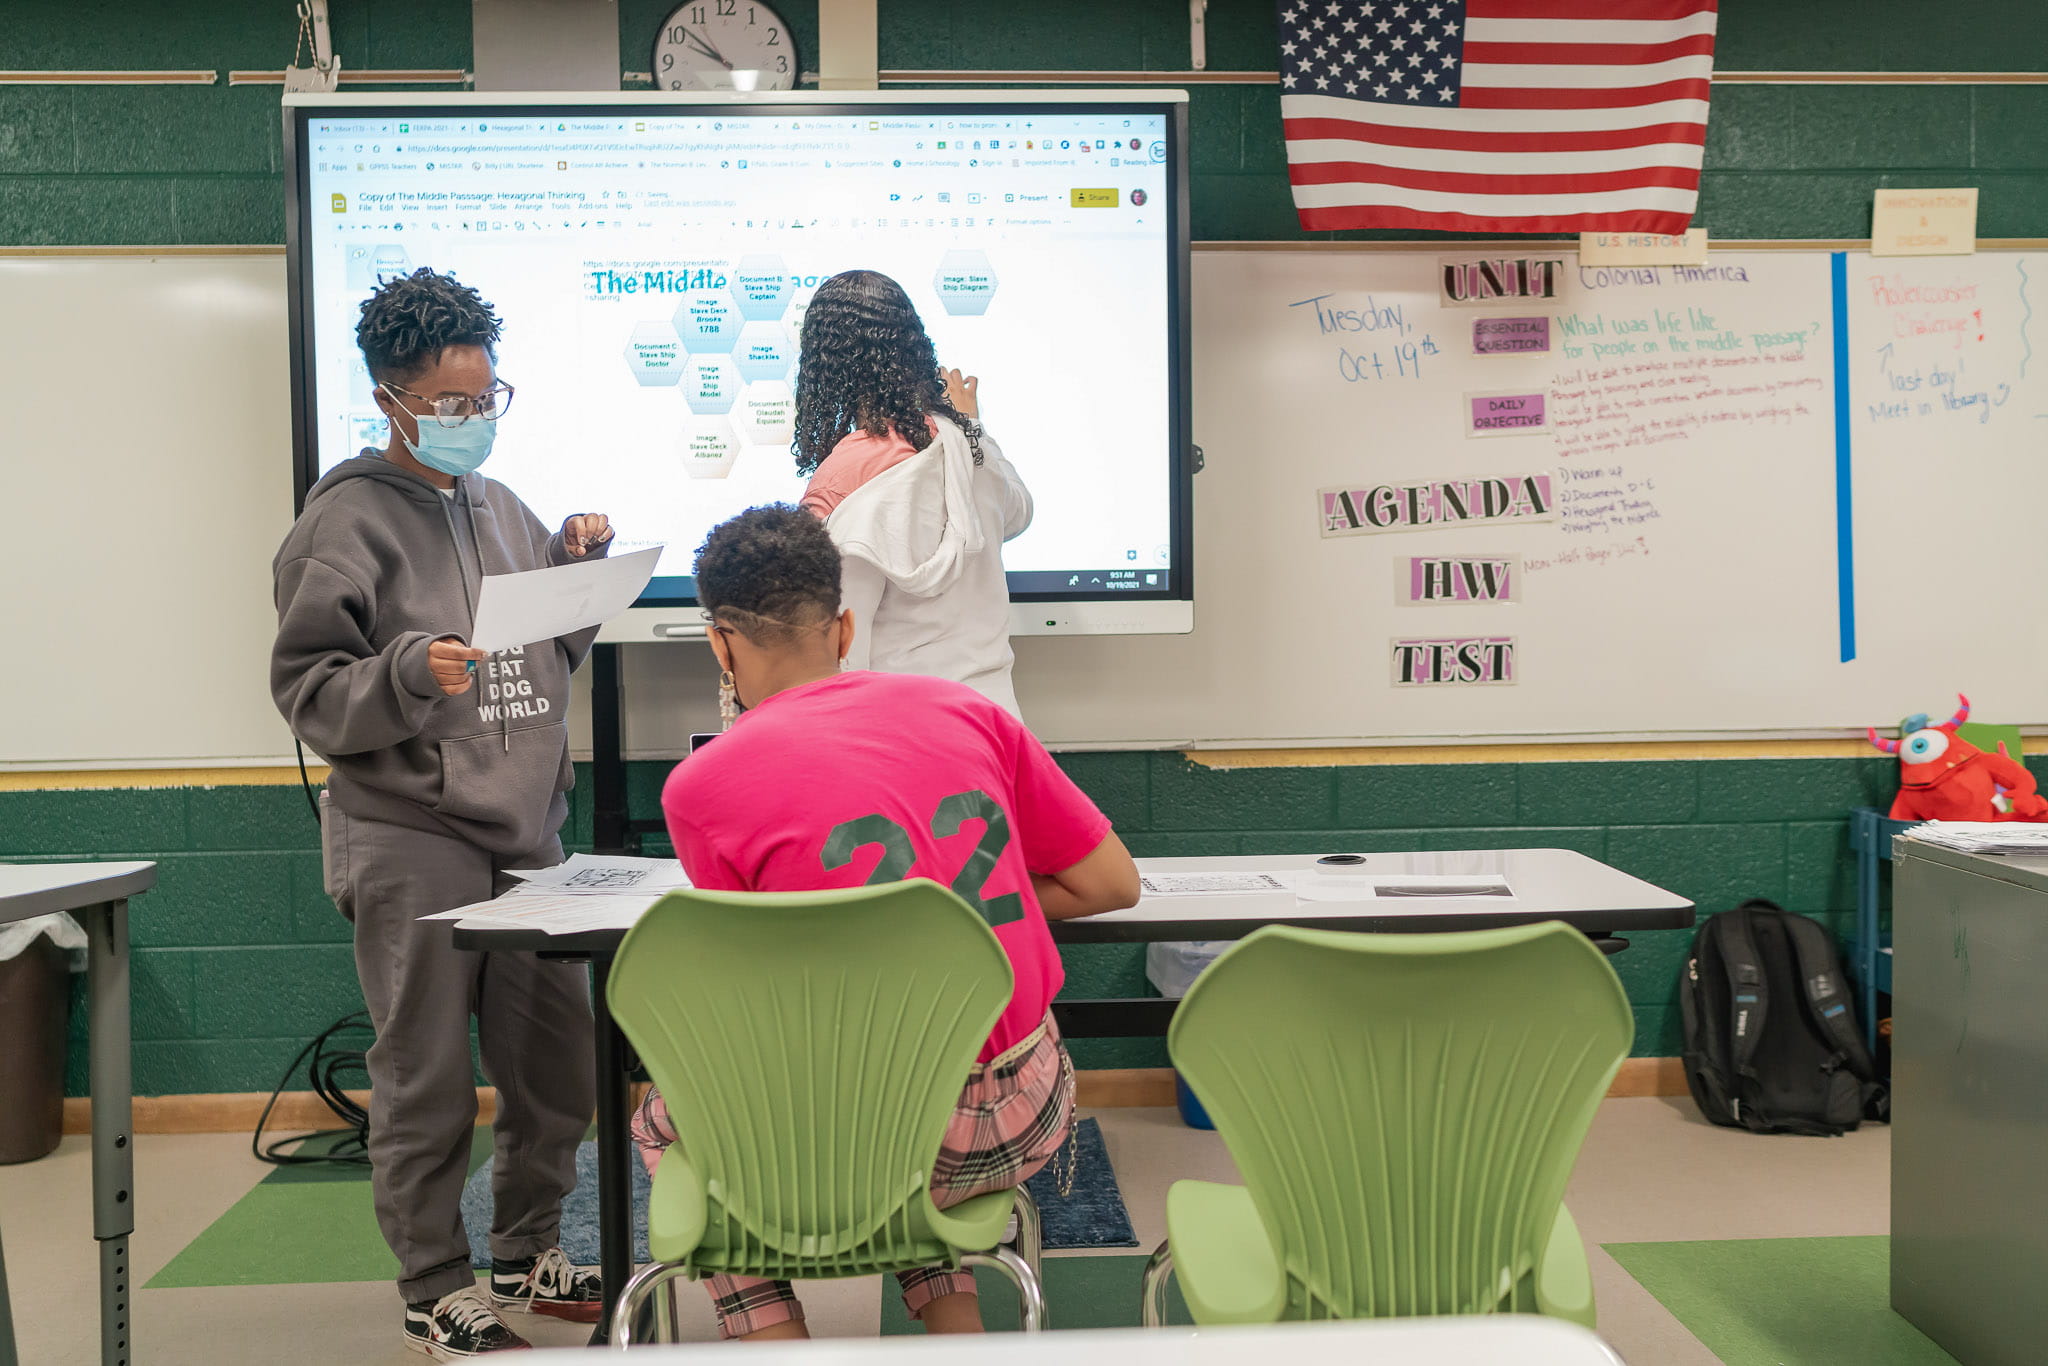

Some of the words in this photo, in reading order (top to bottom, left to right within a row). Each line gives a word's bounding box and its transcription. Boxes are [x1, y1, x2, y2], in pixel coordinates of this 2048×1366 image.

[692, 7, 706, 24] 11
[715, 0, 736, 16] 12
[748, 8, 756, 25] 1
[667, 26, 685, 44] 10
[767, 28, 780, 45] 2
[662, 54, 674, 72] 9
[776, 55, 788, 73] 3
[332, 162, 347, 171] Apps
[359, 192, 383, 202] Copy
[386, 191, 396, 200] of
[398, 192, 415, 201] The
[417, 191, 448, 200] Middle
[498, 191, 545, 202] Hexagonal
[548, 190, 586, 202] Thinking
[1020, 193, 1048, 202] Present
[1089, 193, 1109, 202] Share
[359, 203, 372, 211] File
[379, 203, 393, 211] Edit
[401, 203, 419, 211] View
[426, 203, 447, 211] Insert
[489, 202, 507, 210] Slide
[515, 203, 543, 212] Arrange
[551, 202, 570, 210] Tools
[616, 202, 632, 211] Help
[1597, 237, 1623, 248] U.S.
[1627, 236, 1689, 247] HISTORY
[592, 270, 639, 293] The
[644, 268, 728, 293] Middle
[1444, 259, 1564, 301] UNIT
[1580, 265, 1660, 290] Colonial
[1673, 265, 1750, 283] America
[943, 284, 959, 292] Ship
[960, 284, 990, 292] Diagram
[749, 293, 776, 301] Captain
[700, 325, 720, 333] 1788
[1475, 322, 1545, 336] ESSENTIAL
[1557, 313, 1605, 337] What
[1611, 317, 1649, 336] was
[1653, 308, 1682, 334] life
[1687, 307, 1719, 332] like
[1476, 339, 1544, 352] QUESTION
[1562, 339, 1584, 360] for
[1591, 339, 1637, 362] people
[1642, 341, 1660, 353] on
[1667, 336, 1690, 352] the
[1696, 330, 1743, 351] middle
[703, 383, 719, 391] Ship
[1887, 368, 1924, 392] last
[748, 400, 785, 408] Document
[1488, 399, 1527, 411] DAILY
[1867, 399, 1910, 423] Meet
[1917, 401, 1933, 416] in
[1474, 413, 1544, 428] OBJECTIVE
[1328, 476, 1549, 531] AGENDA
[1123, 571, 1136, 579] AM
[1422, 560, 1512, 600] HW
[489, 659, 524, 678] EAT
[1393, 643, 1514, 684] TEST
[489, 679, 533, 700] DOG
[478, 697, 550, 722] WORLD
[819, 789, 1025, 928] 22
